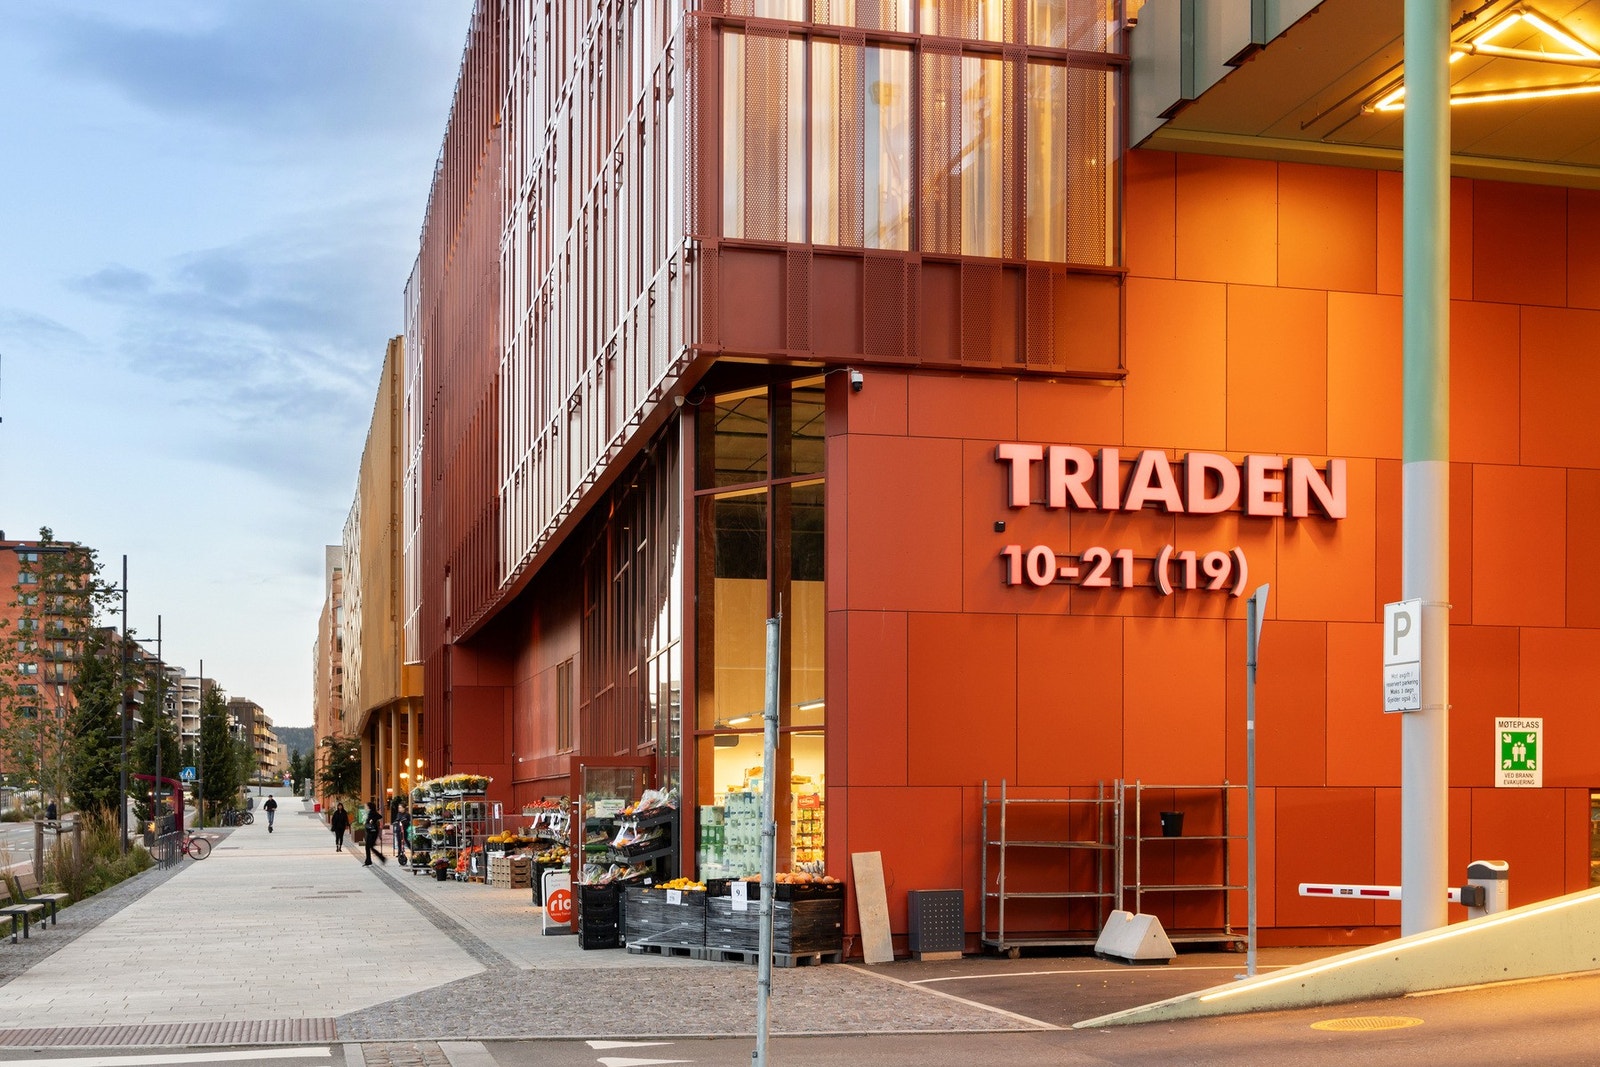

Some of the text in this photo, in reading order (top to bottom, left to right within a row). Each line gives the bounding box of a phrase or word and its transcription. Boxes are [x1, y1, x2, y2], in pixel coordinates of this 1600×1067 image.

[995, 443, 1347, 519] TRIADEN
[1000, 543, 1249, 597] 10-21 (19)
[1393, 611, 1412, 656] P
[1498, 720, 1540, 729] MØTEPLASS
